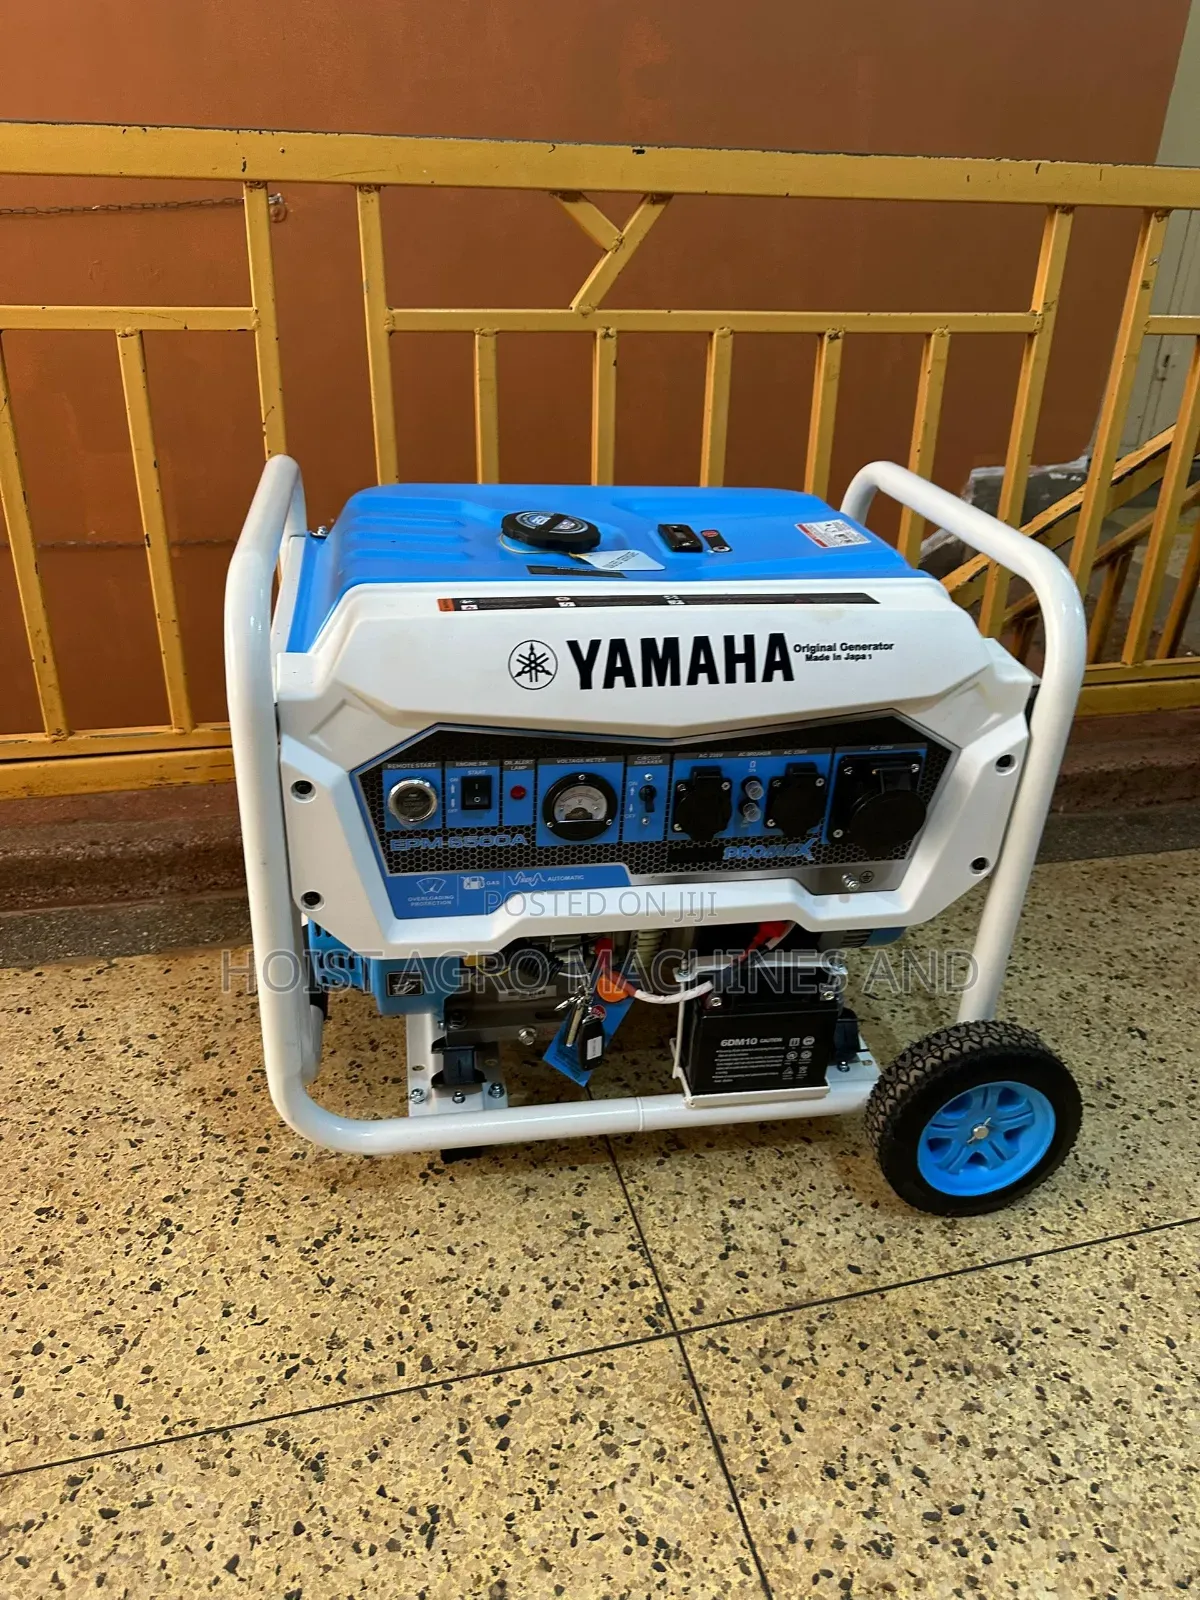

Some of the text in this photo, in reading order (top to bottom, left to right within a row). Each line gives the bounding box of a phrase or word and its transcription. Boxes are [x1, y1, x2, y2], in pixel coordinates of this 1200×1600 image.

[793, 642, 895, 654] Original Generator
[566, 632, 795, 690] YAMAHA
[805, 653, 830, 661] Made
[547, 874, 585, 882] AUTOMATIC
[720, 1037, 758, 1047] 6DM10
